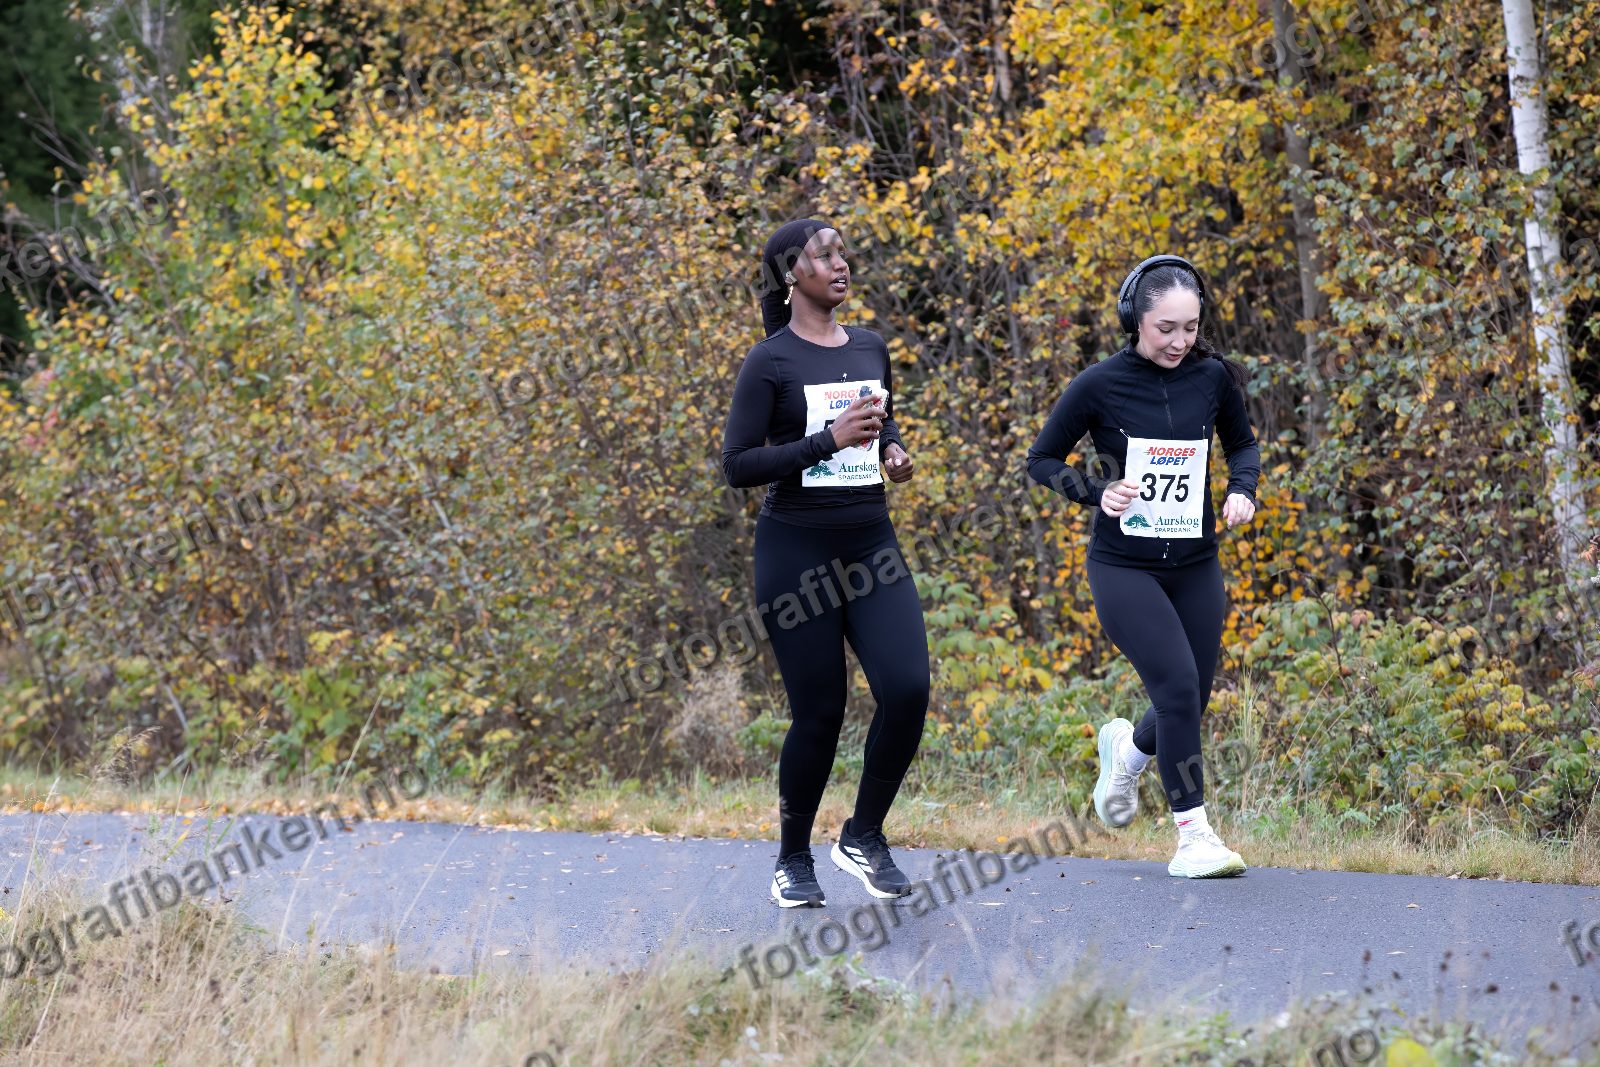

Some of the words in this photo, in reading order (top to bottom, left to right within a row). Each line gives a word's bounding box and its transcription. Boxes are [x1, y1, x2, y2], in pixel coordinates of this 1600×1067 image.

[824, 389, 860, 400] NORG
[829, 399, 854, 410] LØP
[1144, 446, 1197, 457] NORGES
[1149, 456, 1188, 466] LØPET
[838, 461, 878, 474] Aurskog
[1139, 472, 1190, 503] 375
[1154, 515, 1200, 529] Aurskog
